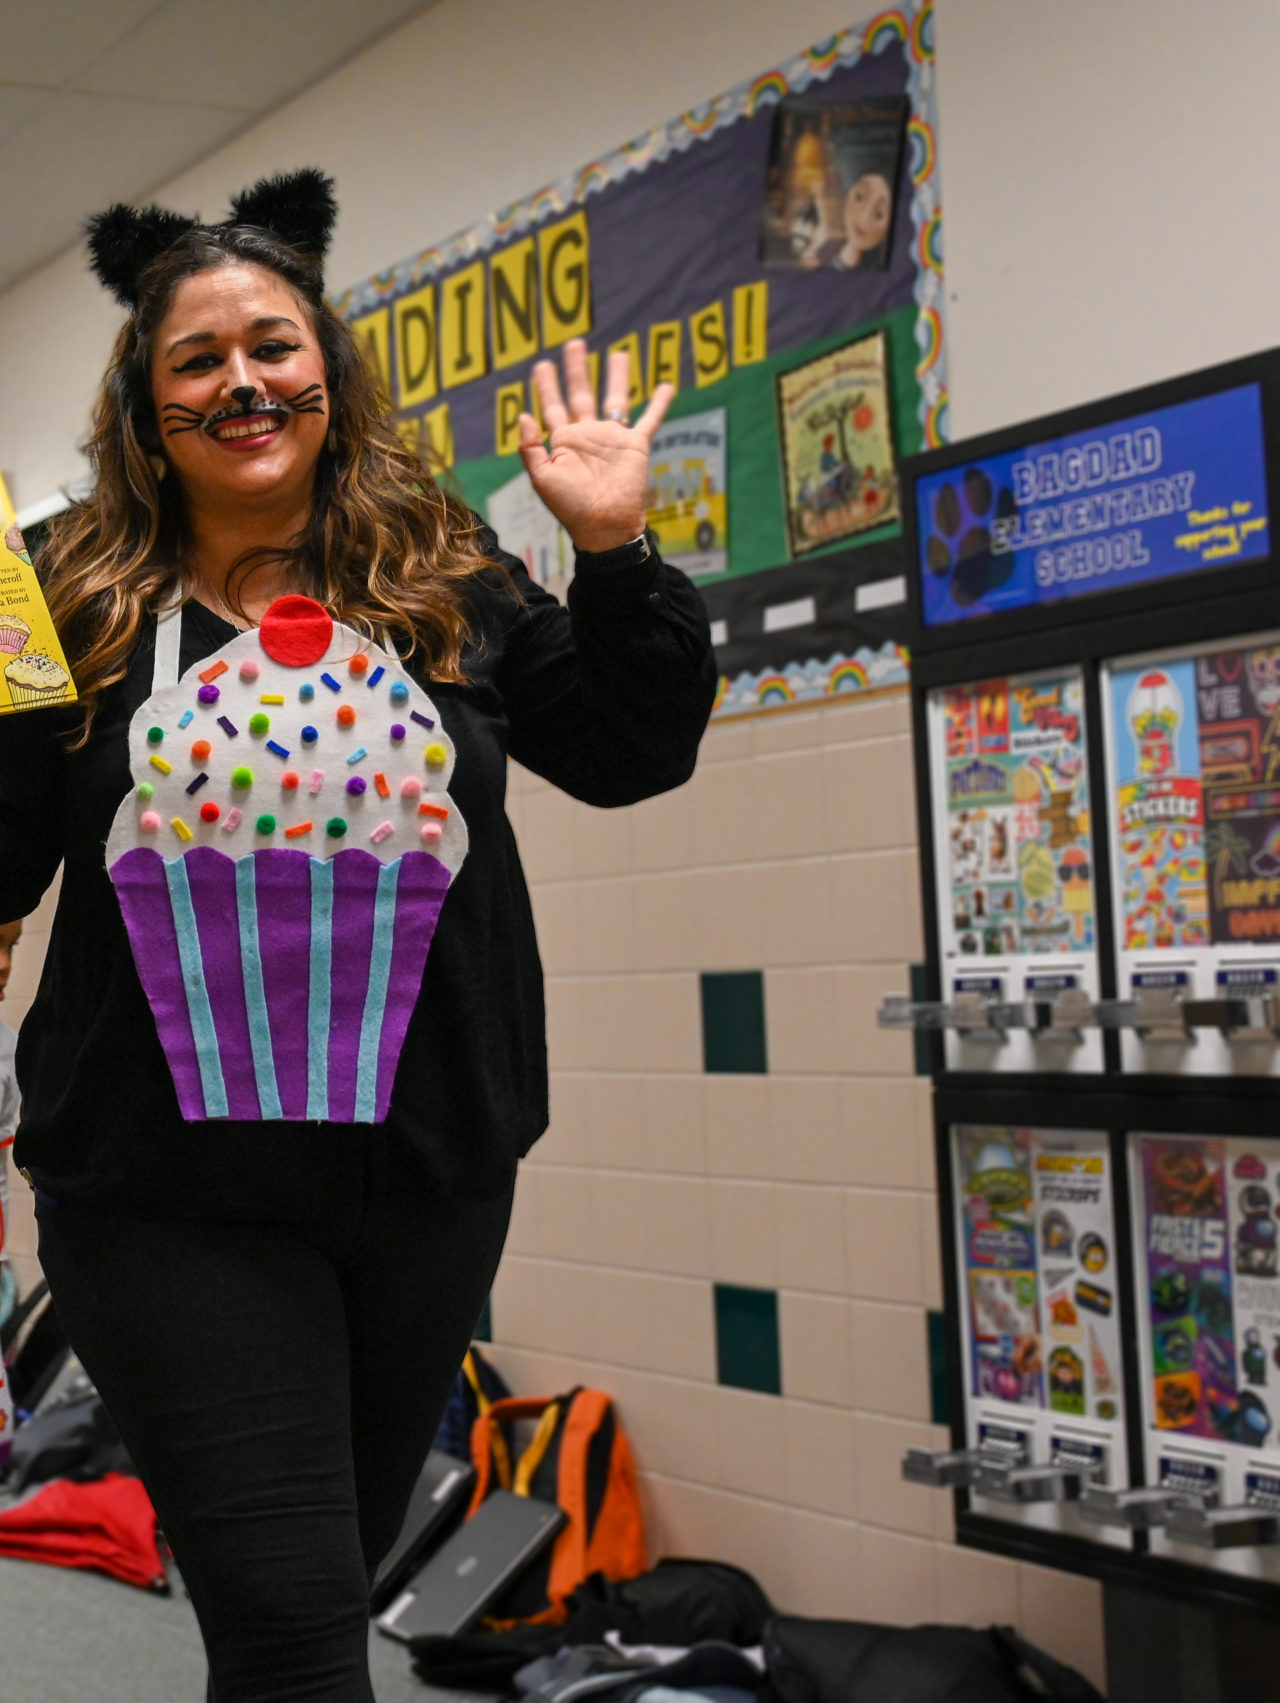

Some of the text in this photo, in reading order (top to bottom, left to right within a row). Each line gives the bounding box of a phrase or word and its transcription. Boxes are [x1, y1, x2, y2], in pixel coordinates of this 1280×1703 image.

[1012, 426, 1162, 505] BAGDAD
[991, 471, 1195, 555] ELEMENTARY
[1035, 530, 1150, 587] SCHOOL
[6, 594, 30, 606] Bond
